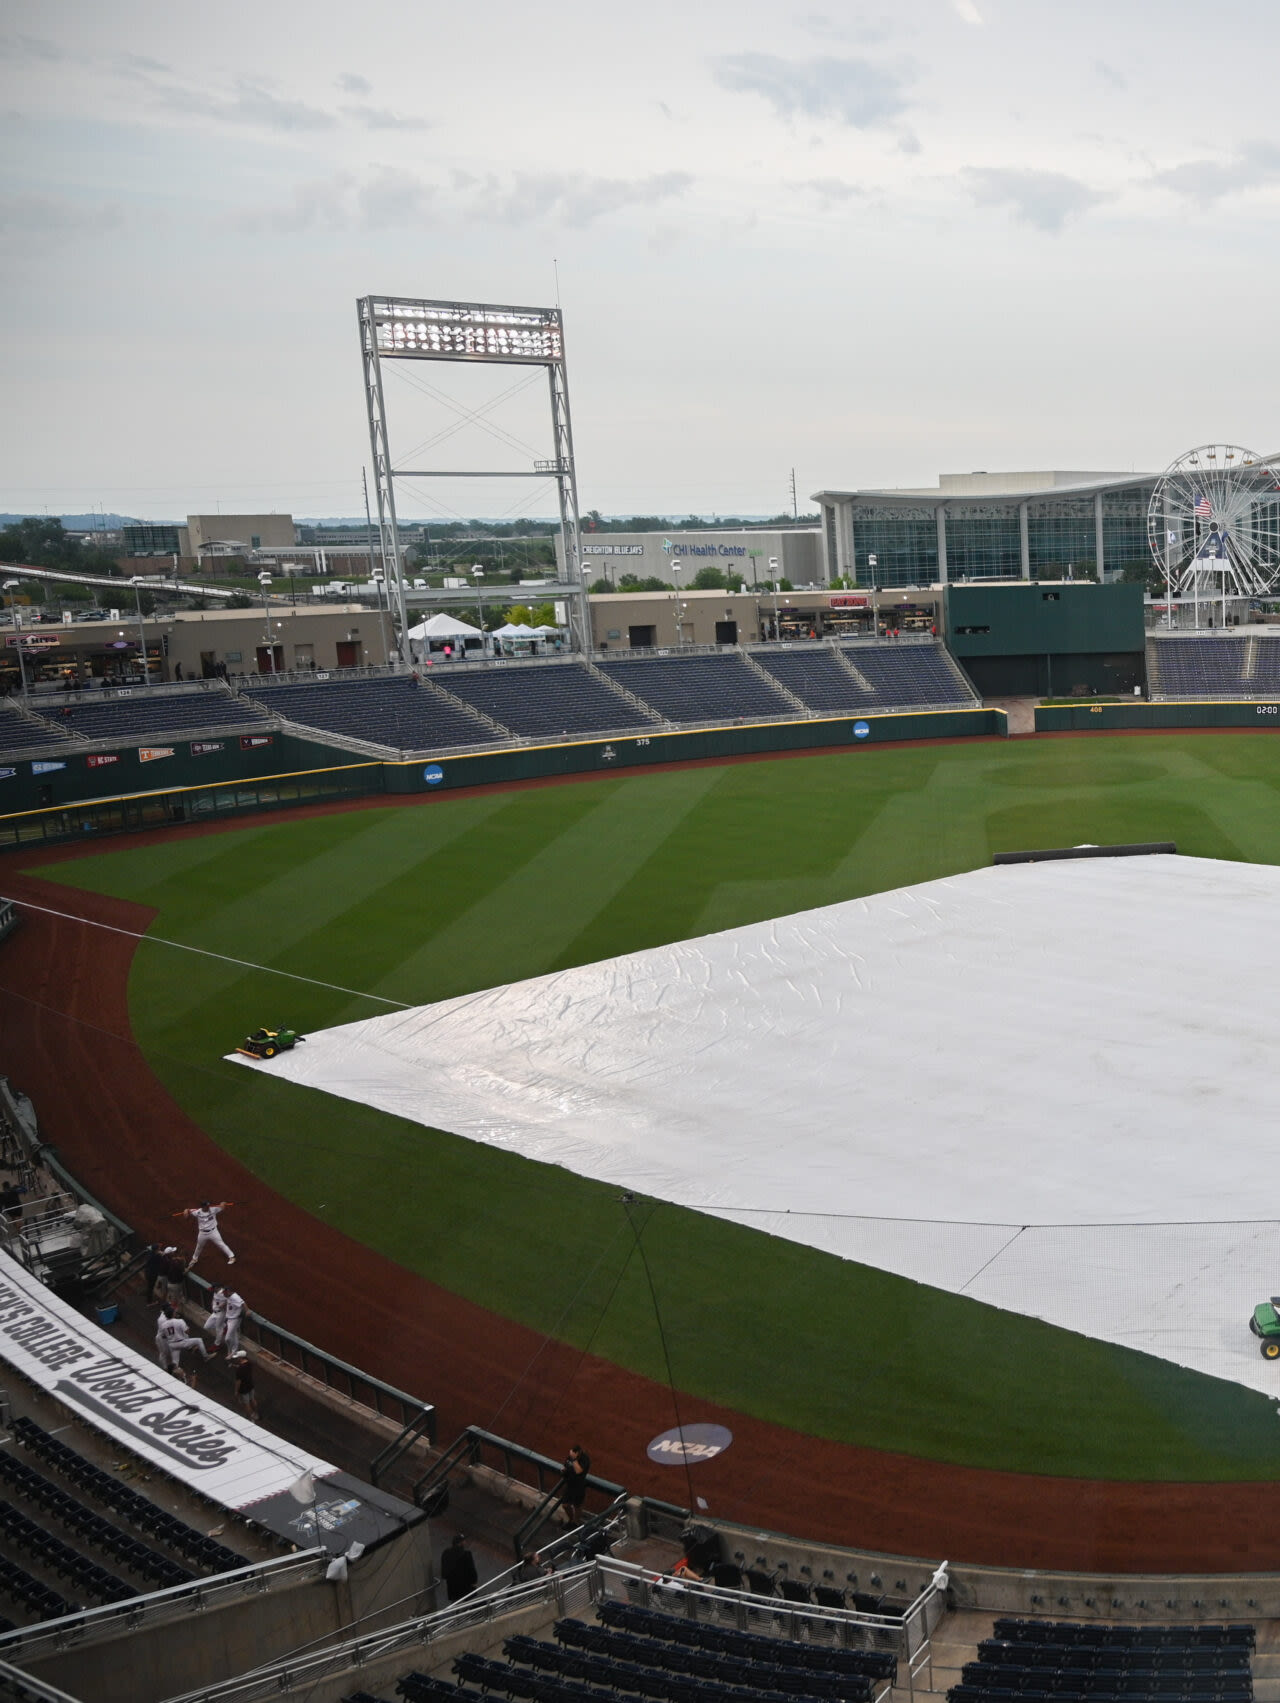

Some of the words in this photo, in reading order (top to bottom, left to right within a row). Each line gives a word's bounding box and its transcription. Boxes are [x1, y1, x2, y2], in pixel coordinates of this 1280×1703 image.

[582, 546, 612, 554] CREIGHTON
[614, 544, 643, 554] BLUEJAYS
[673, 544, 688, 556] CHI
[690, 544, 717, 556] Health
[718, 544, 746, 556] Center
[1256, 706, 1278, 714] 02:00
[168, 1326, 175, 1336] 17
[3, 1316, 95, 1371] COLLEGE
[70, 1357, 174, 1414] World
[139, 1405, 238, 1464] Series
[650, 1440, 721, 1458] NCAA
